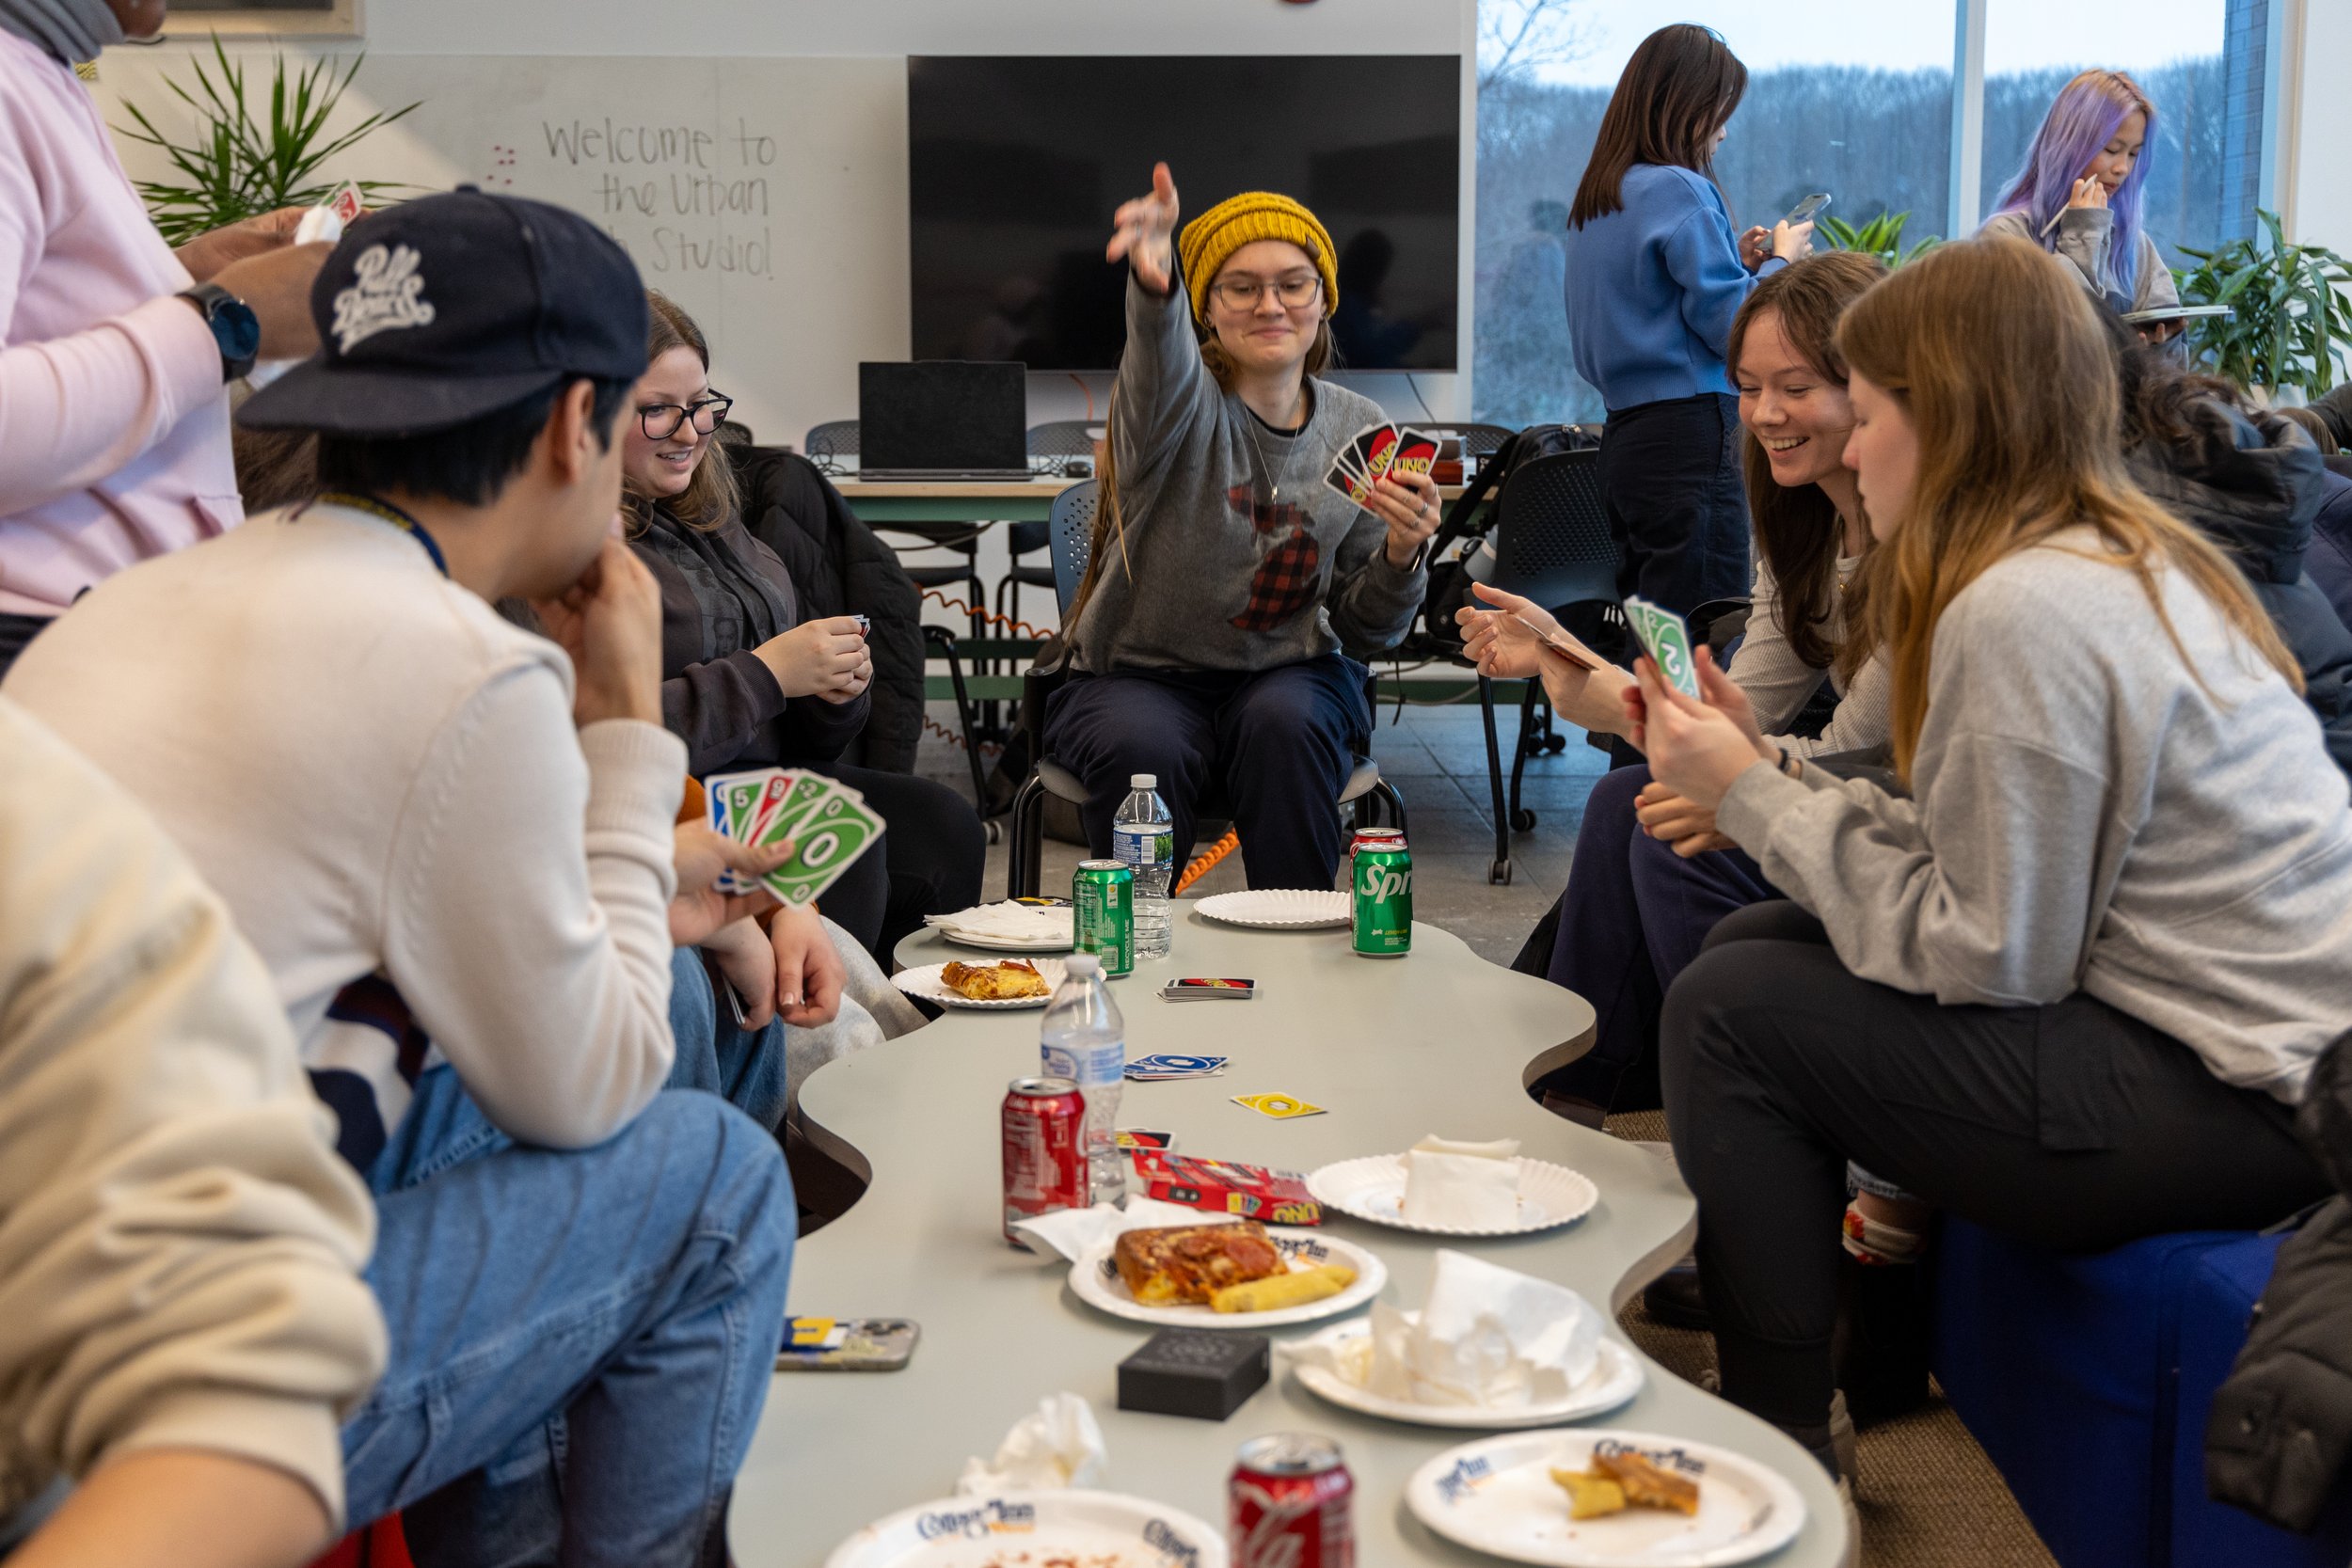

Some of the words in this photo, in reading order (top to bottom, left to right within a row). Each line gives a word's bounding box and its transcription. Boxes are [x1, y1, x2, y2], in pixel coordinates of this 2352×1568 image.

[542, 117, 712, 168] Welcome
[730, 117, 777, 166] to
[595, 173, 656, 217] the
[670, 173, 770, 216] Urban
[1392, 457, 1431, 474] UNO
[803, 832, 840, 867] 0
[1360, 865, 1412, 903] Spr
[1272, 1203, 1320, 1223] UNO
